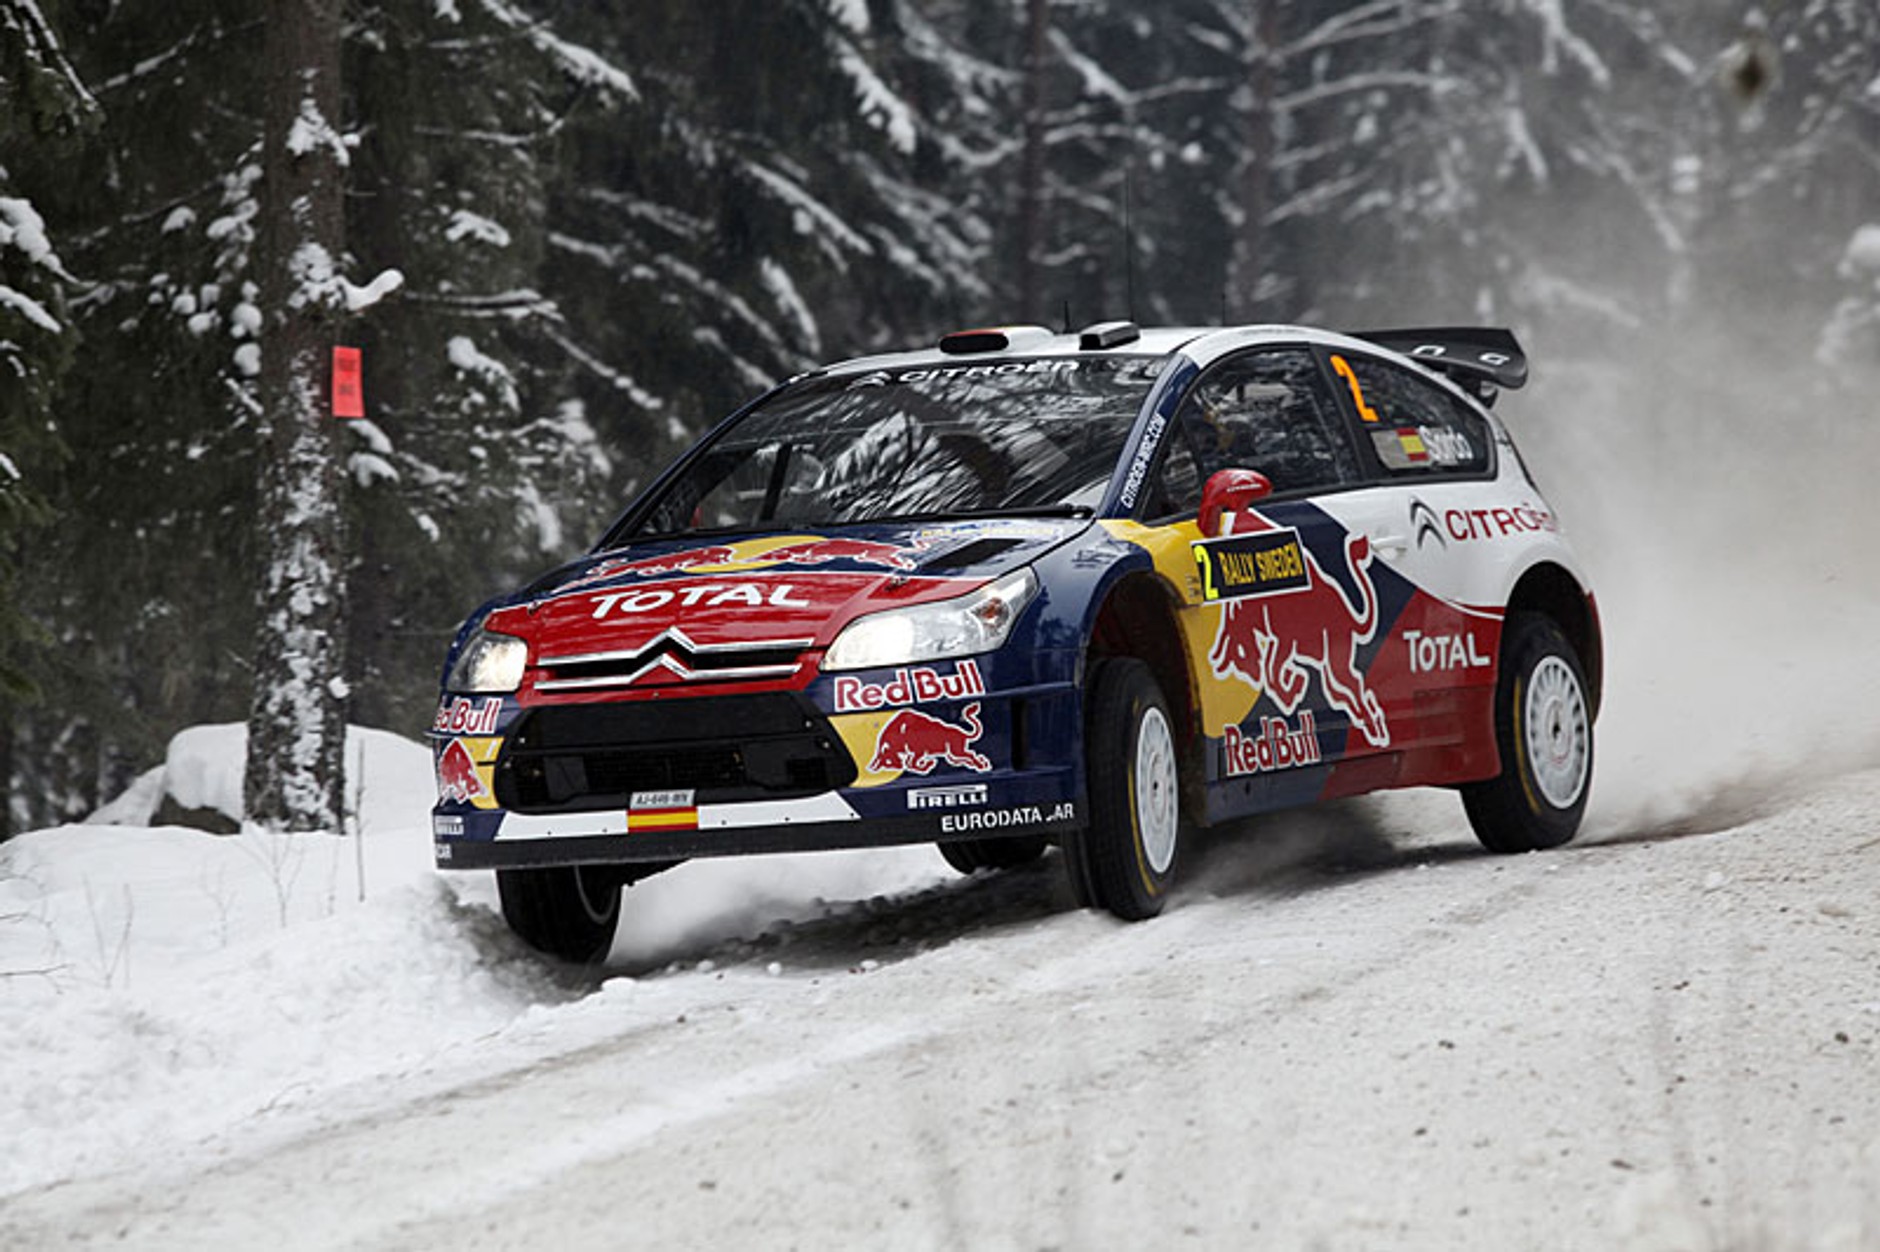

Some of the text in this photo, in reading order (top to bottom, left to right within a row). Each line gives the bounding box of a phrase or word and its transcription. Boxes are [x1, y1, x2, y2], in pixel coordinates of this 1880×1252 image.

[1330, 354, 1379, 422] 2
[1193, 544, 1219, 600] 2
[1217, 551, 1257, 586] RALLY
[1255, 541, 1304, 581] SWEDEN
[590, 584, 810, 619] TOTAL
[1402, 629, 1491, 674] TOTAL
[834, 658, 986, 713] Red Bull
[450, 698, 503, 734] Bull
[1223, 708, 1321, 777] Red Bull
[907, 784, 988, 809] PIRELLI
